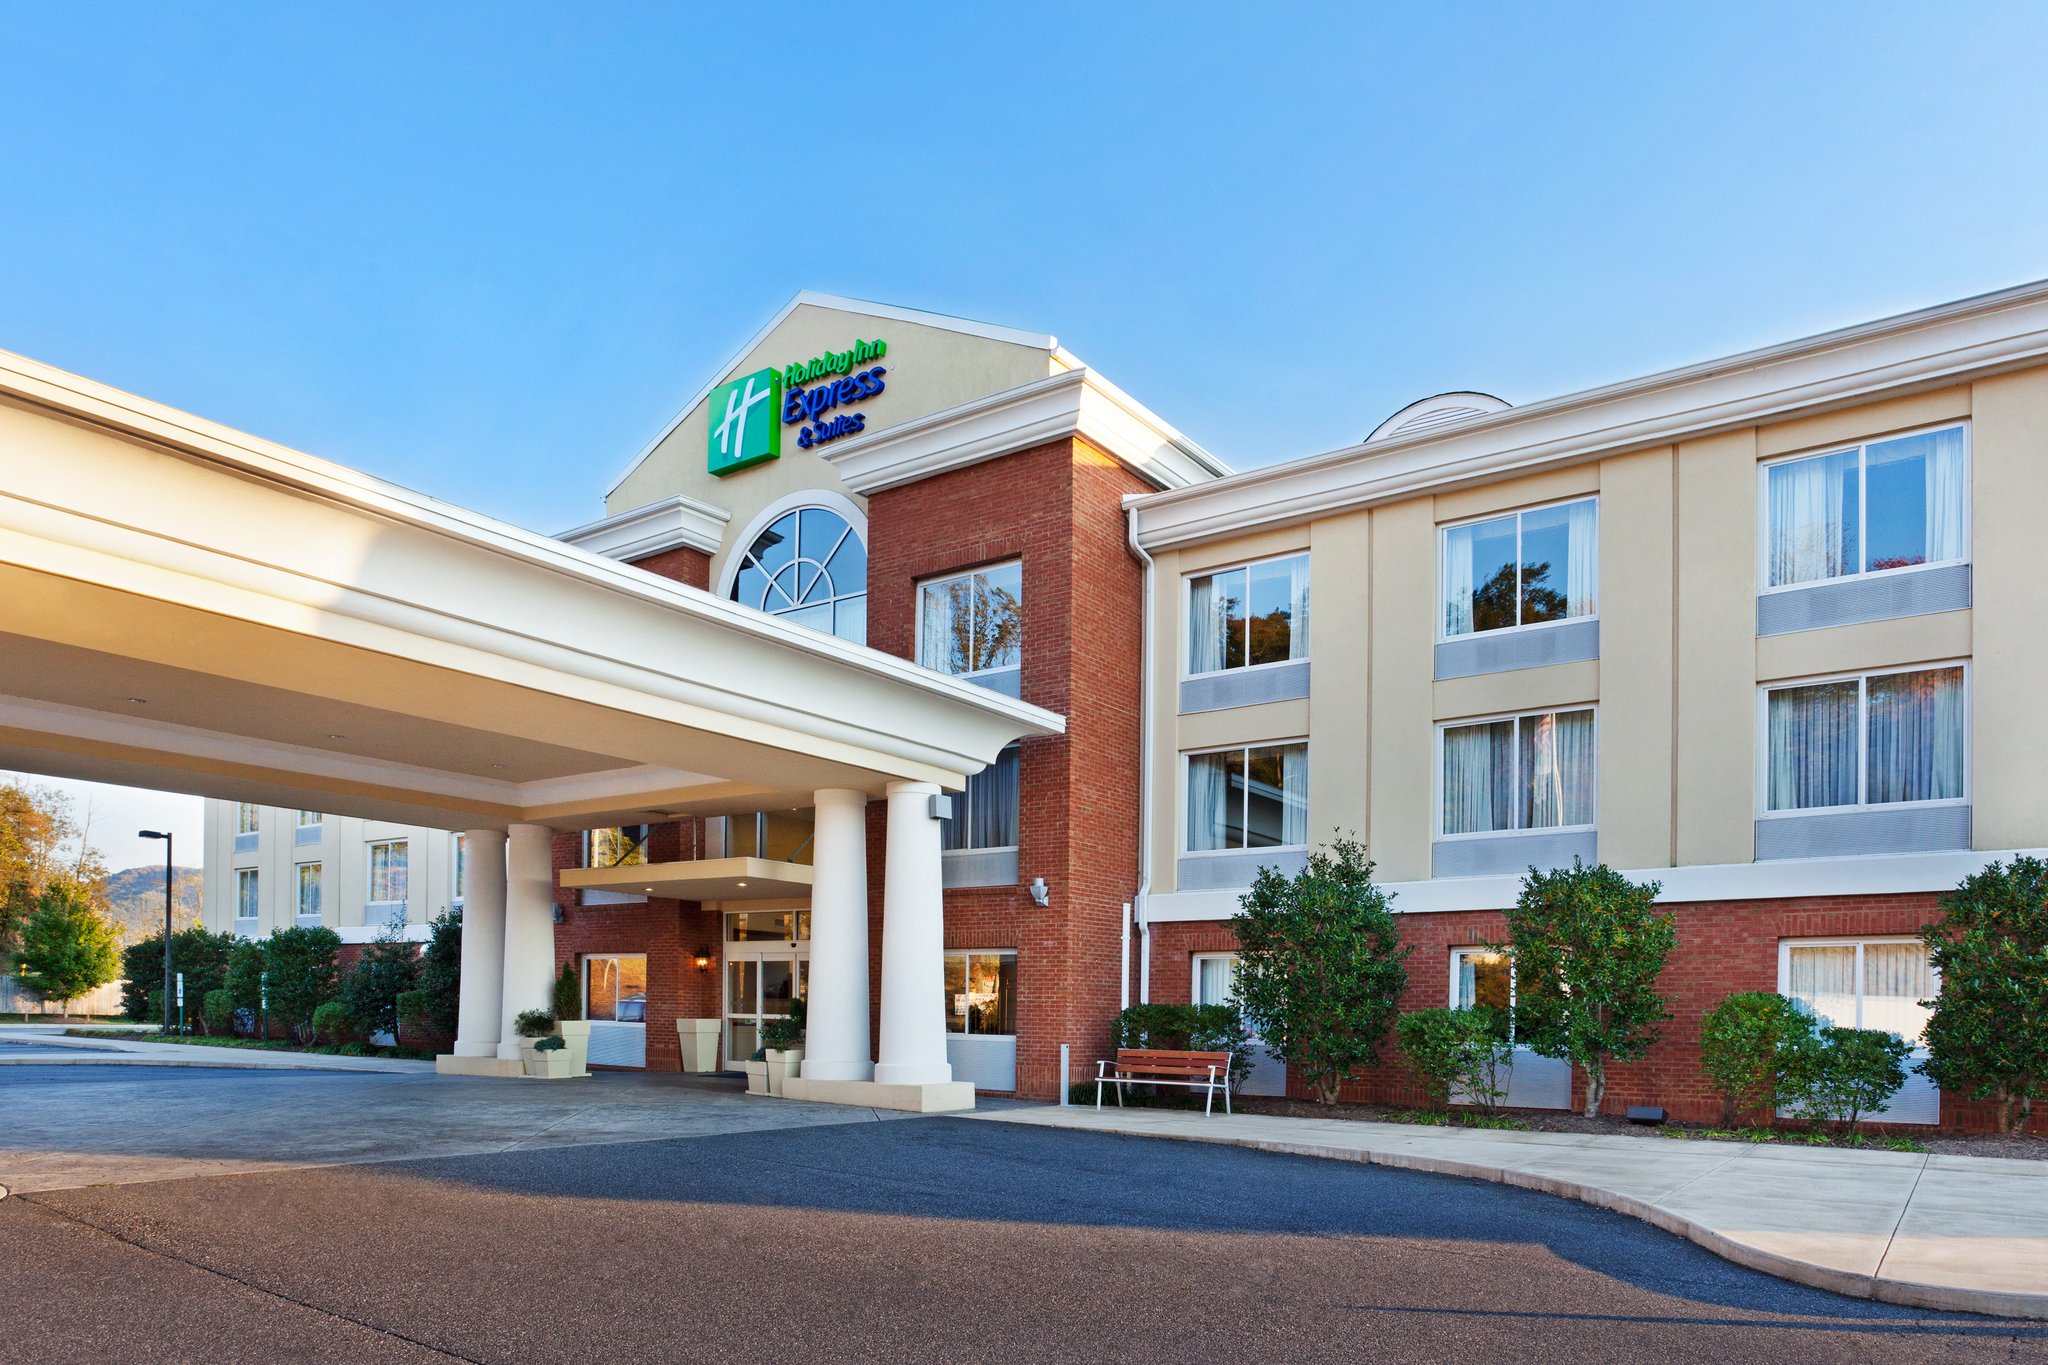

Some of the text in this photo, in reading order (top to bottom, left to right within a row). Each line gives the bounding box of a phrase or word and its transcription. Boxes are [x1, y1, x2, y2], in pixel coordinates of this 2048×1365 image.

[783, 338, 887, 390] Holiday Inn
[782, 366, 887, 425] Express
[797, 412, 866, 449] & Suites
